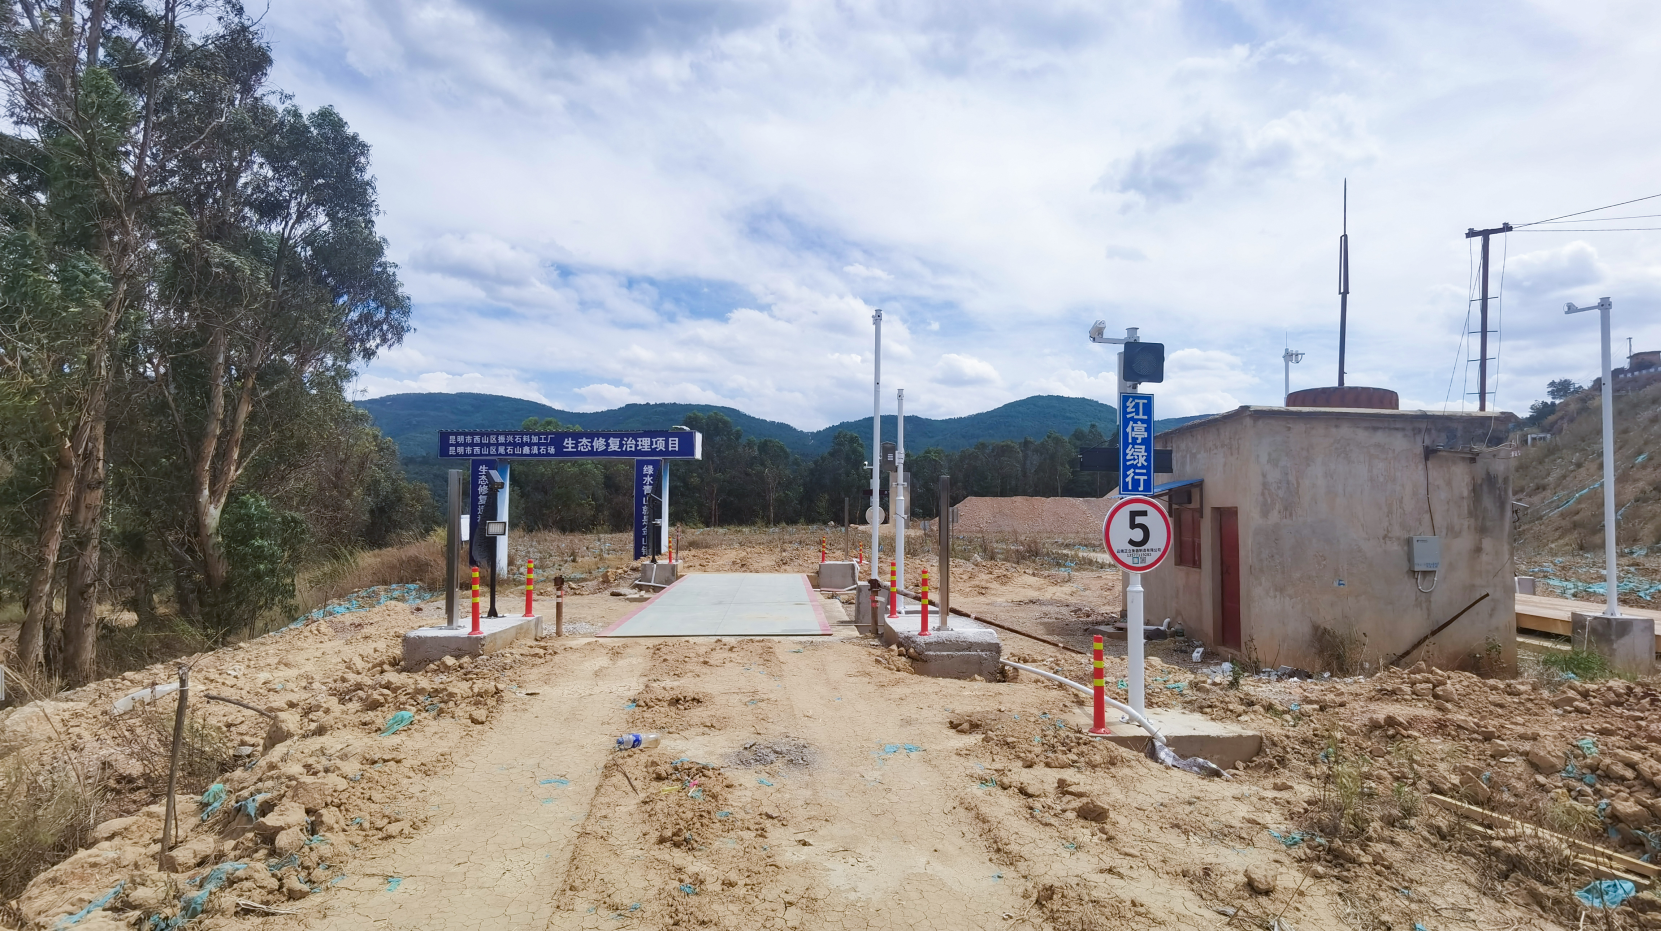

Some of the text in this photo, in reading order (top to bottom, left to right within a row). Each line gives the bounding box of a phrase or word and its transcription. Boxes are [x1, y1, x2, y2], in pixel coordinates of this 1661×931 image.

[449, 435, 555, 444] 昆明市西山区振兴石料加工厂
[563, 437, 680, 452] 生态修复治理项目
[1125, 397, 1148, 492] 红停绿行
[1127, 509, 1151, 548] 5
